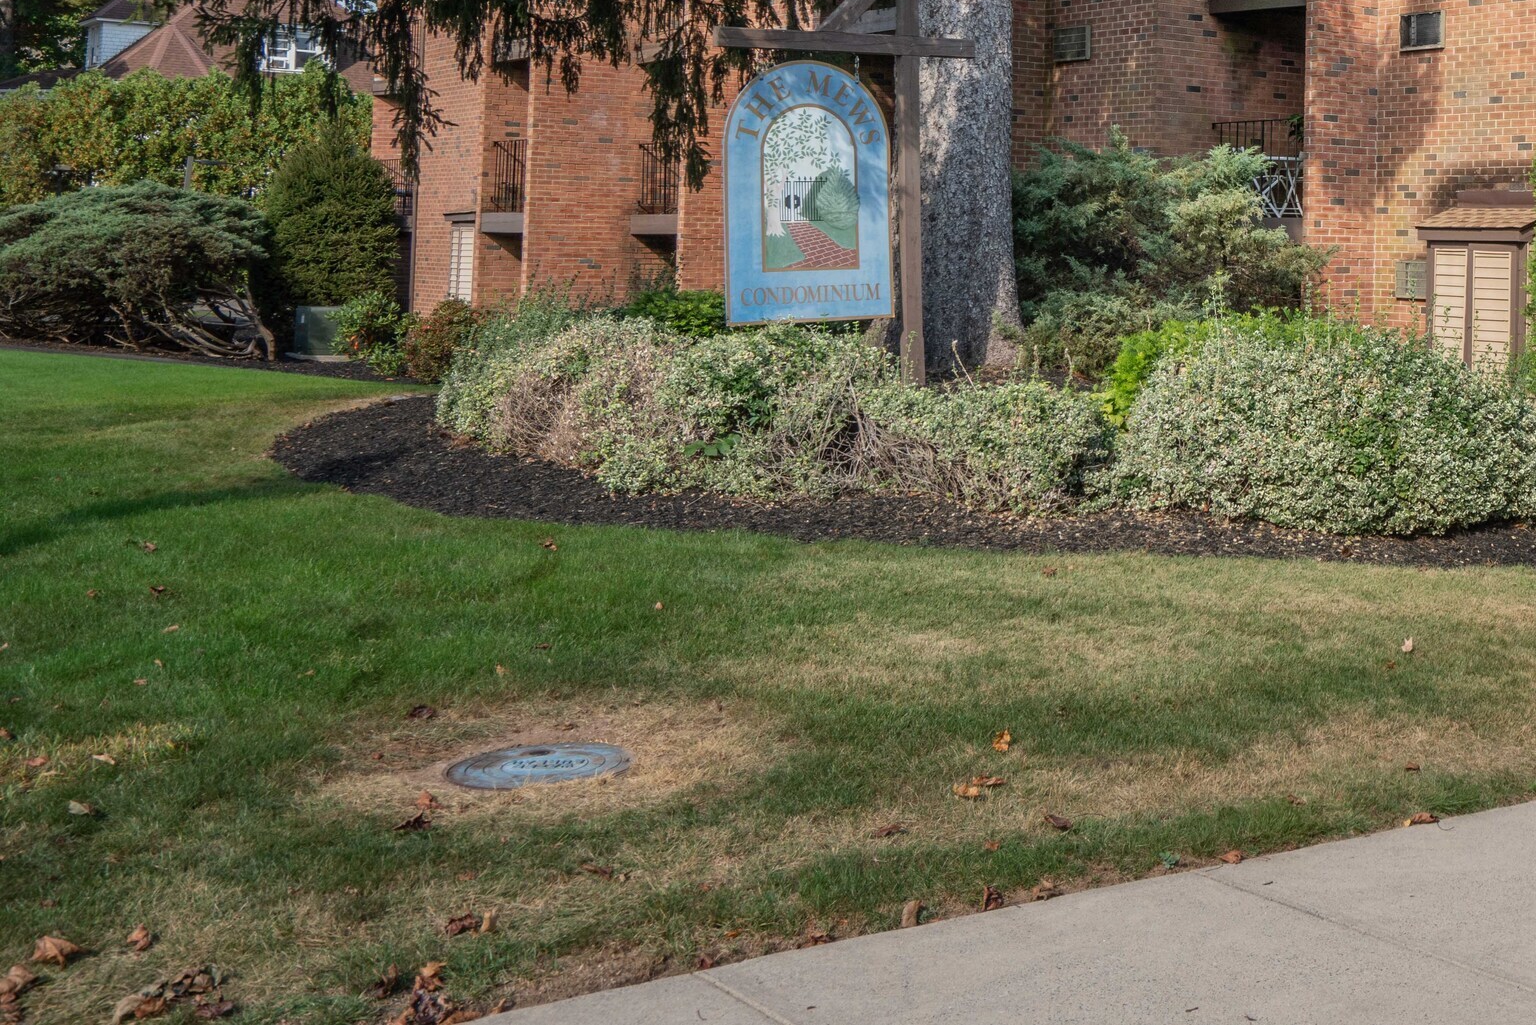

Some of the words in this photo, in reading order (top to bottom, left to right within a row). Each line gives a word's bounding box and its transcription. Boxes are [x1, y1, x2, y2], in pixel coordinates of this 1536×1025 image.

[735, 75, 791, 140] THE
[806, 70, 880, 145] MEWS
[741, 282, 881, 307] CONDOMINIUM
